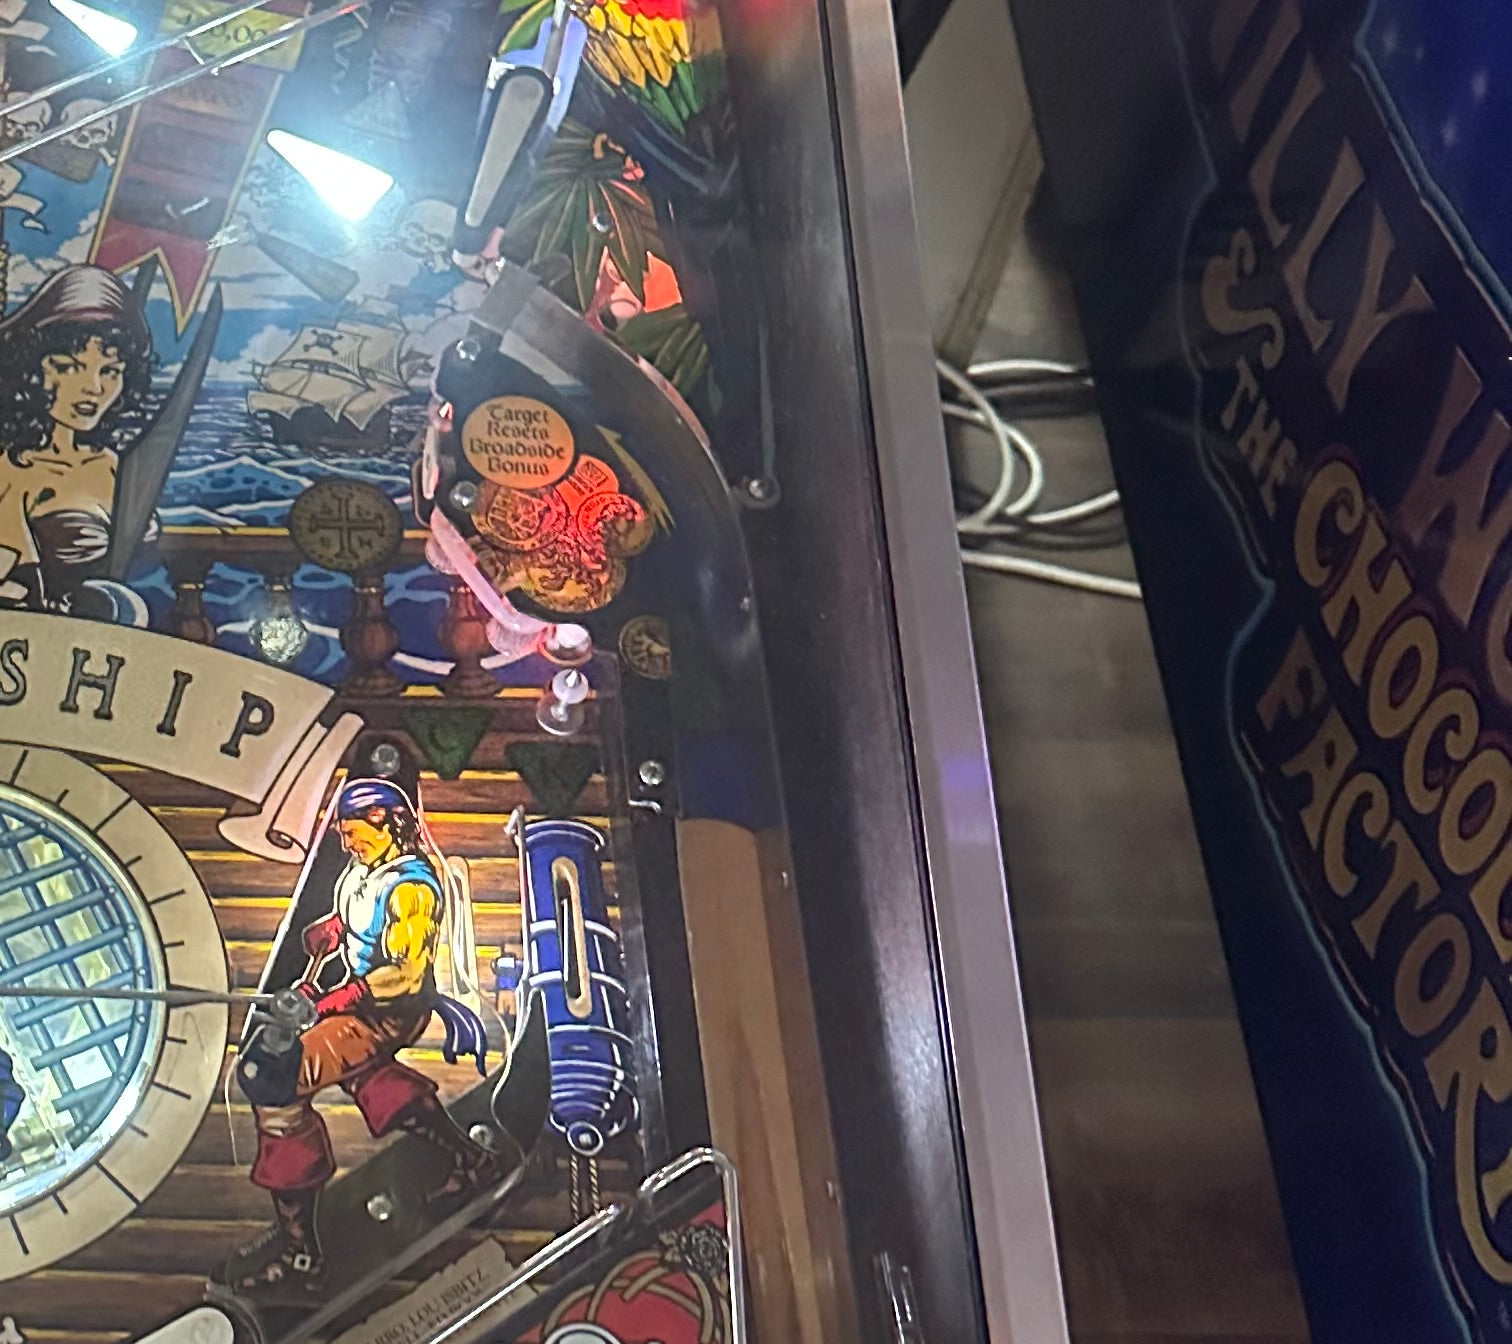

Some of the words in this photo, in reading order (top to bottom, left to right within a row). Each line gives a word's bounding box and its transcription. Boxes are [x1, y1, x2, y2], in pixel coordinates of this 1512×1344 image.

[1218, 356, 1300, 522] THE
[486, 457, 550, 476] Bonus
[408, 1298, 445, 1326] LOU
